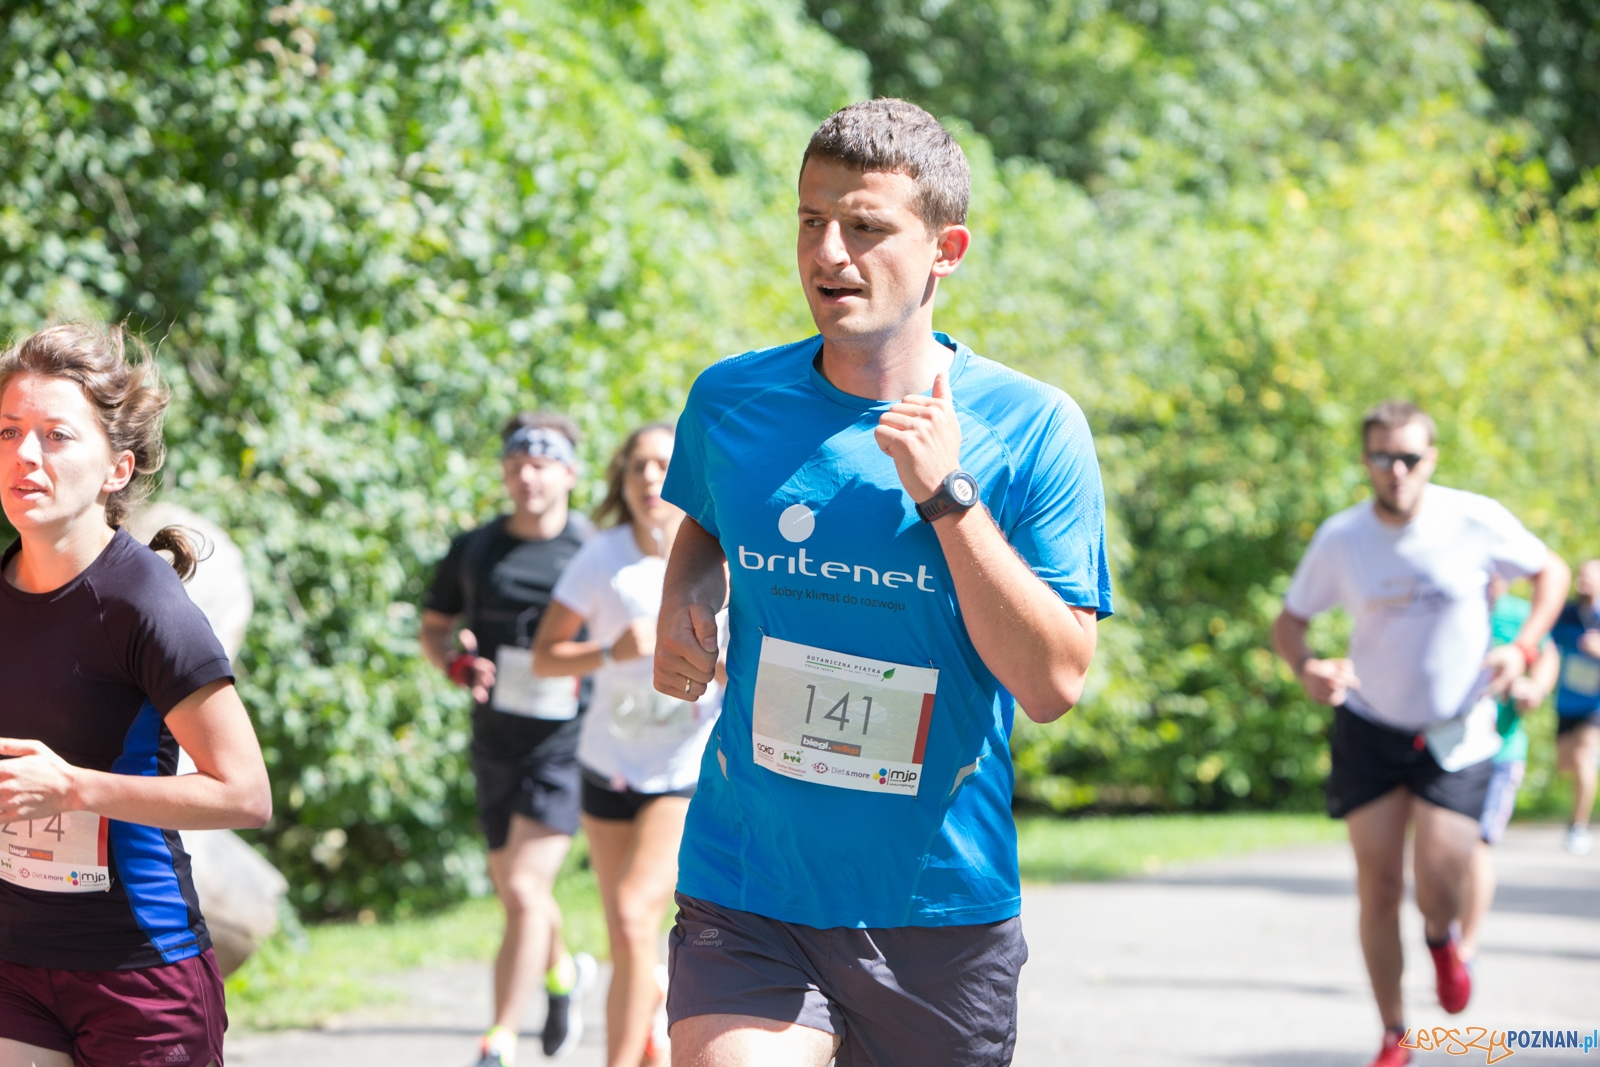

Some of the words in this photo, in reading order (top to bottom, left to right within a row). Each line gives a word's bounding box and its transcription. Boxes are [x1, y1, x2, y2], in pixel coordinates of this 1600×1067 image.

[739, 545, 936, 593] britenet
[771, 585, 803, 601] dobry
[805, 588, 840, 603] klimat
[842, 593, 858, 605] do
[860, 597, 906, 612] rozwoju
[806, 654, 851, 669] BOTANICZNA
[854, 664, 881, 675] PIĄTKA
[805, 684, 873, 735] 141
[831, 766, 845, 776] Diet
[850, 771, 871, 779] more
[890, 769, 917, 783] mjp
[48, 872, 64, 882] more
[82, 871, 106, 883] mjp
